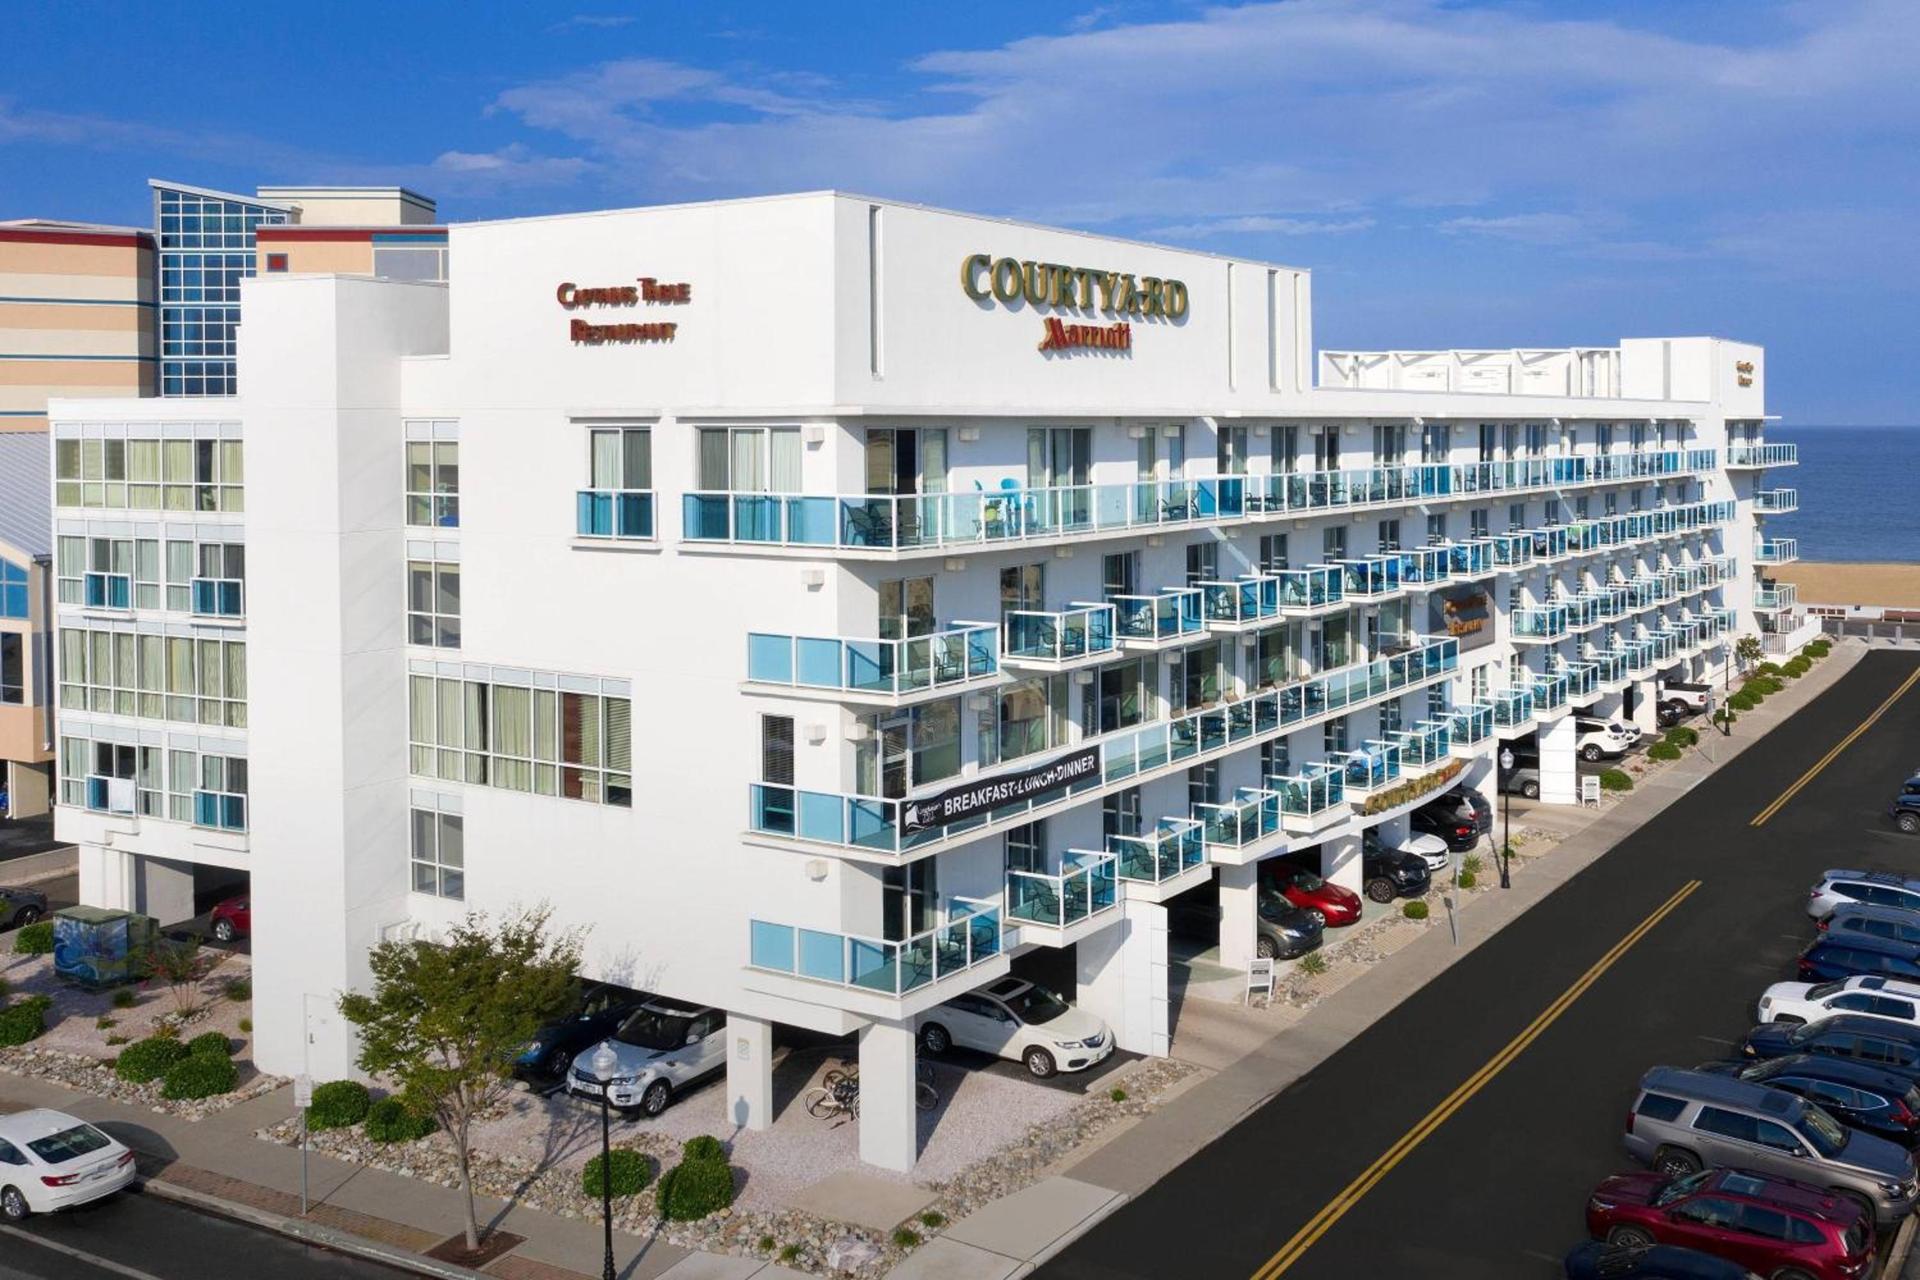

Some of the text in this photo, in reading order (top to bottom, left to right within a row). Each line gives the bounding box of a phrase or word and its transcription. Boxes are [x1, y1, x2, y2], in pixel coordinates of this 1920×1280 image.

[961, 253, 1189, 319] COURTYARD
[1038, 317, 1132, 351] Marriott
[944, 781, 1015, 816] BREAKFAST
